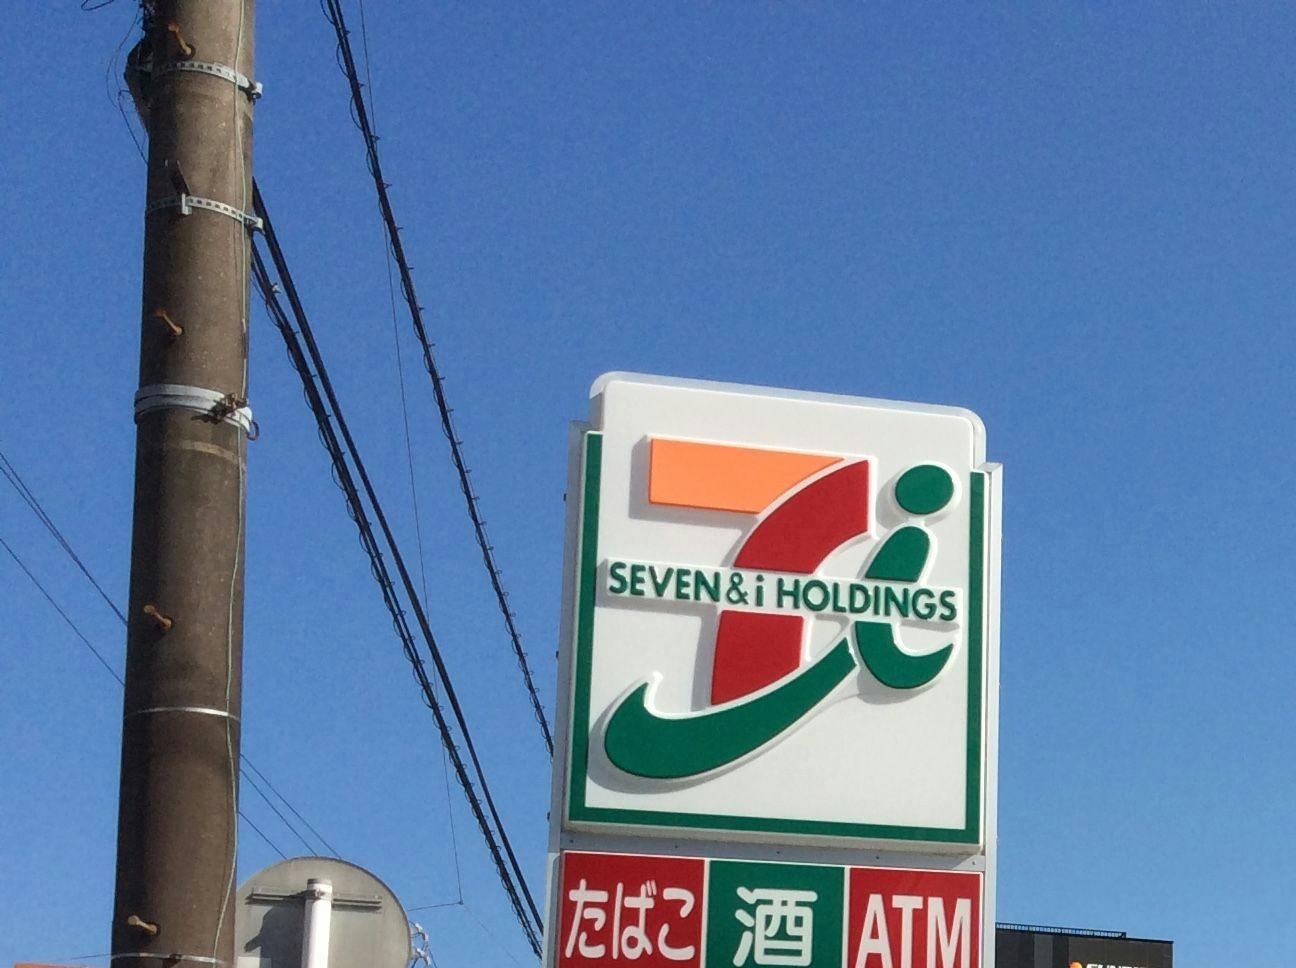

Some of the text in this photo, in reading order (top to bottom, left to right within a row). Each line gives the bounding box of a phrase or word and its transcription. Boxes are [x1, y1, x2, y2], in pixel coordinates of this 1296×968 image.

[776, 577, 957, 622] HOLDINGS
[564, 877, 696, 961] たばこ
[731, 885, 819, 968] 酒
